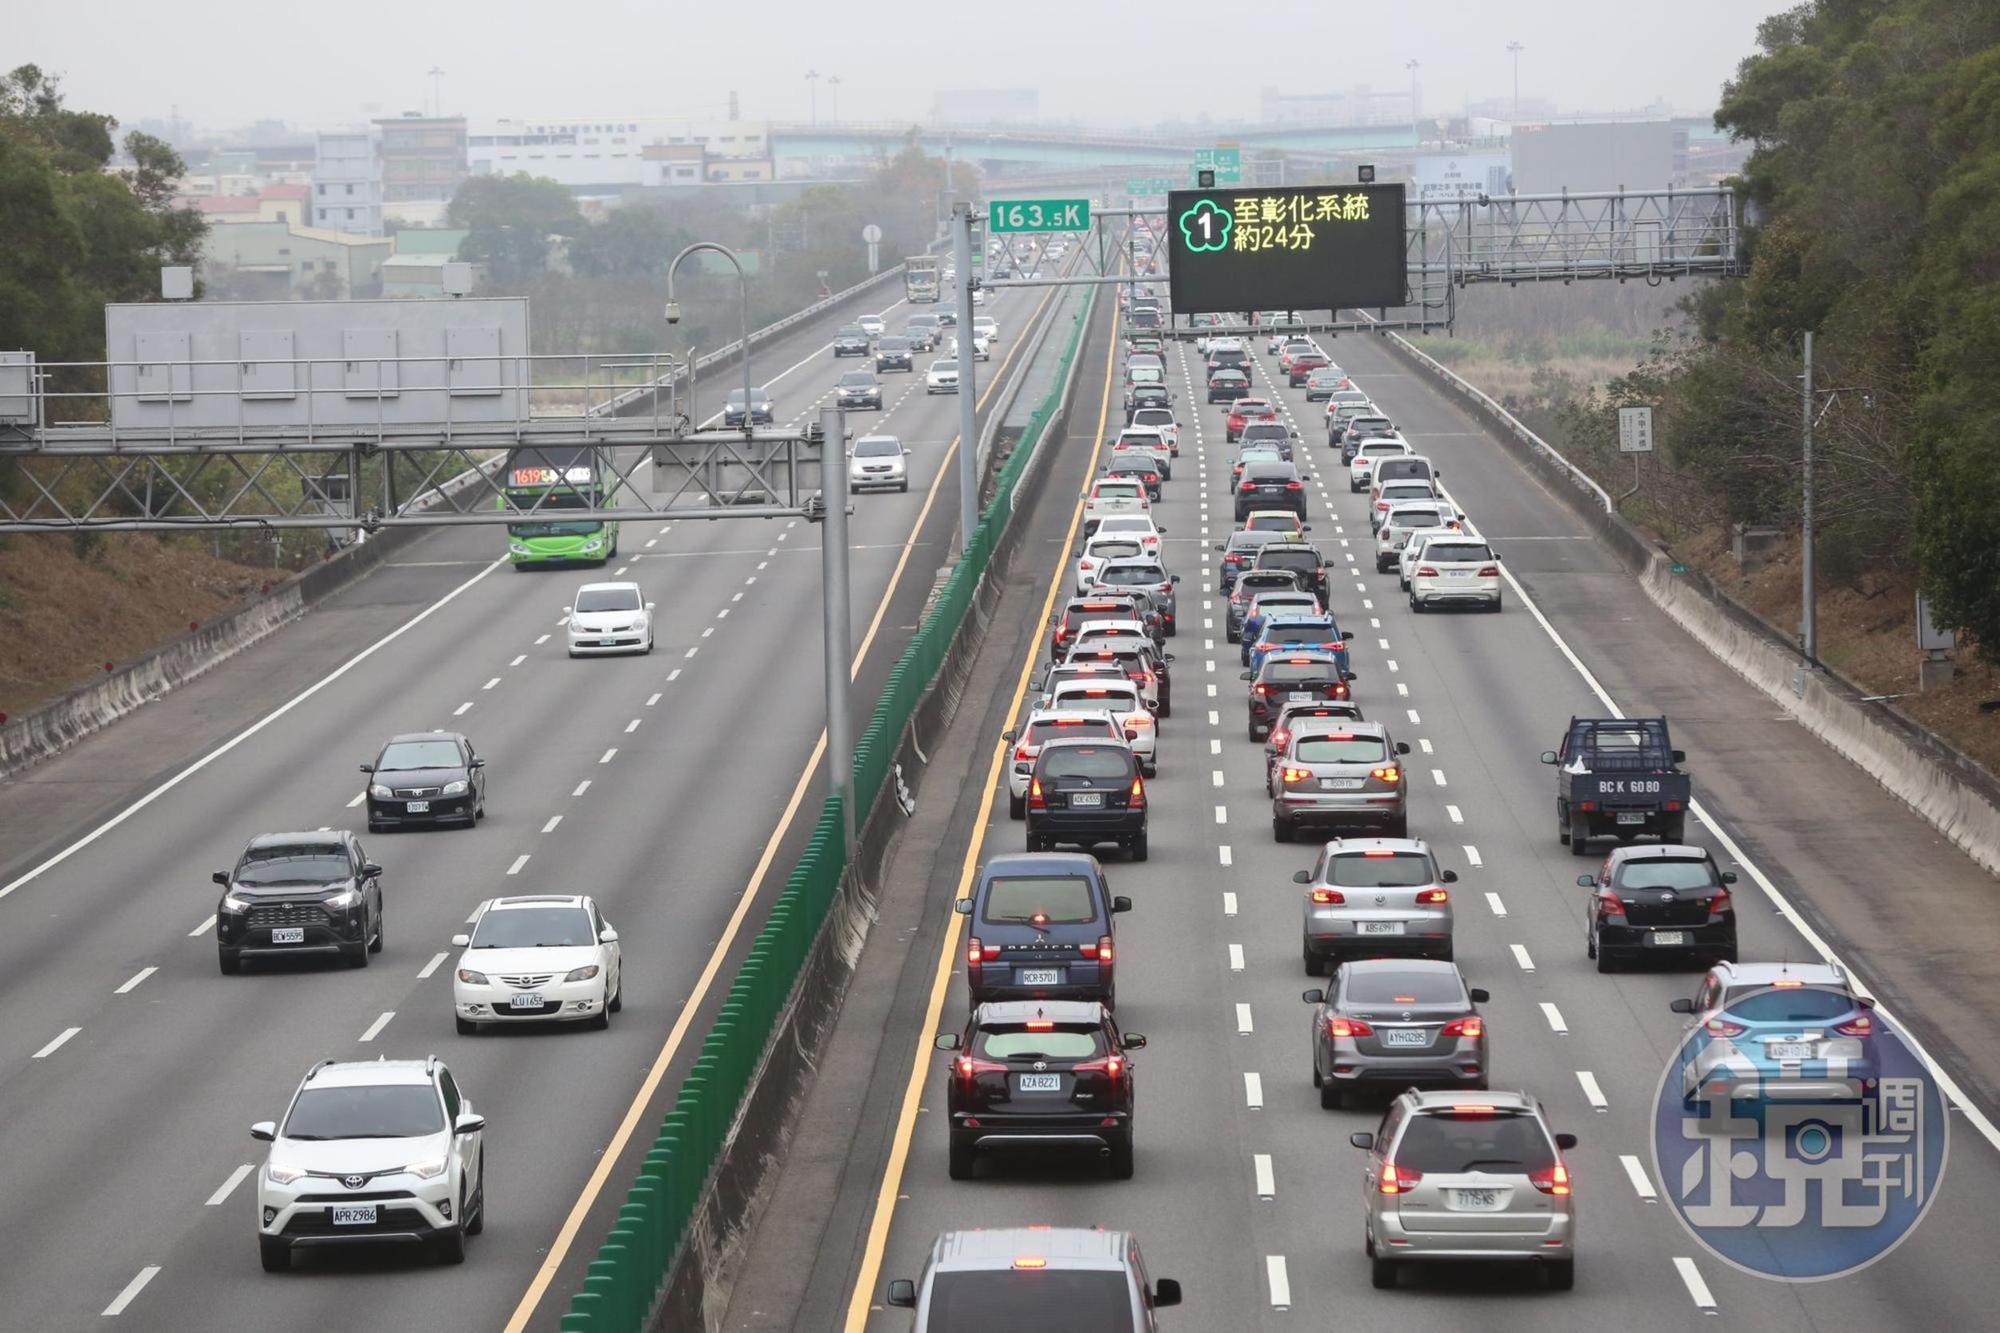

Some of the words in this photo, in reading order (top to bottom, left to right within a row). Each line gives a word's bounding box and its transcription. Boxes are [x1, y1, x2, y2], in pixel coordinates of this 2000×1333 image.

[997, 205, 1081, 227] 163.5K
[1234, 193, 1370, 223] 至彰化系統
[1198, 212, 1211, 240] 1
[1234, 223, 1315, 252] 約24分
[515, 469, 540, 485] 1619
[1599, 781, 1625, 793] BCK
[1630, 781, 1660, 793] 6080
